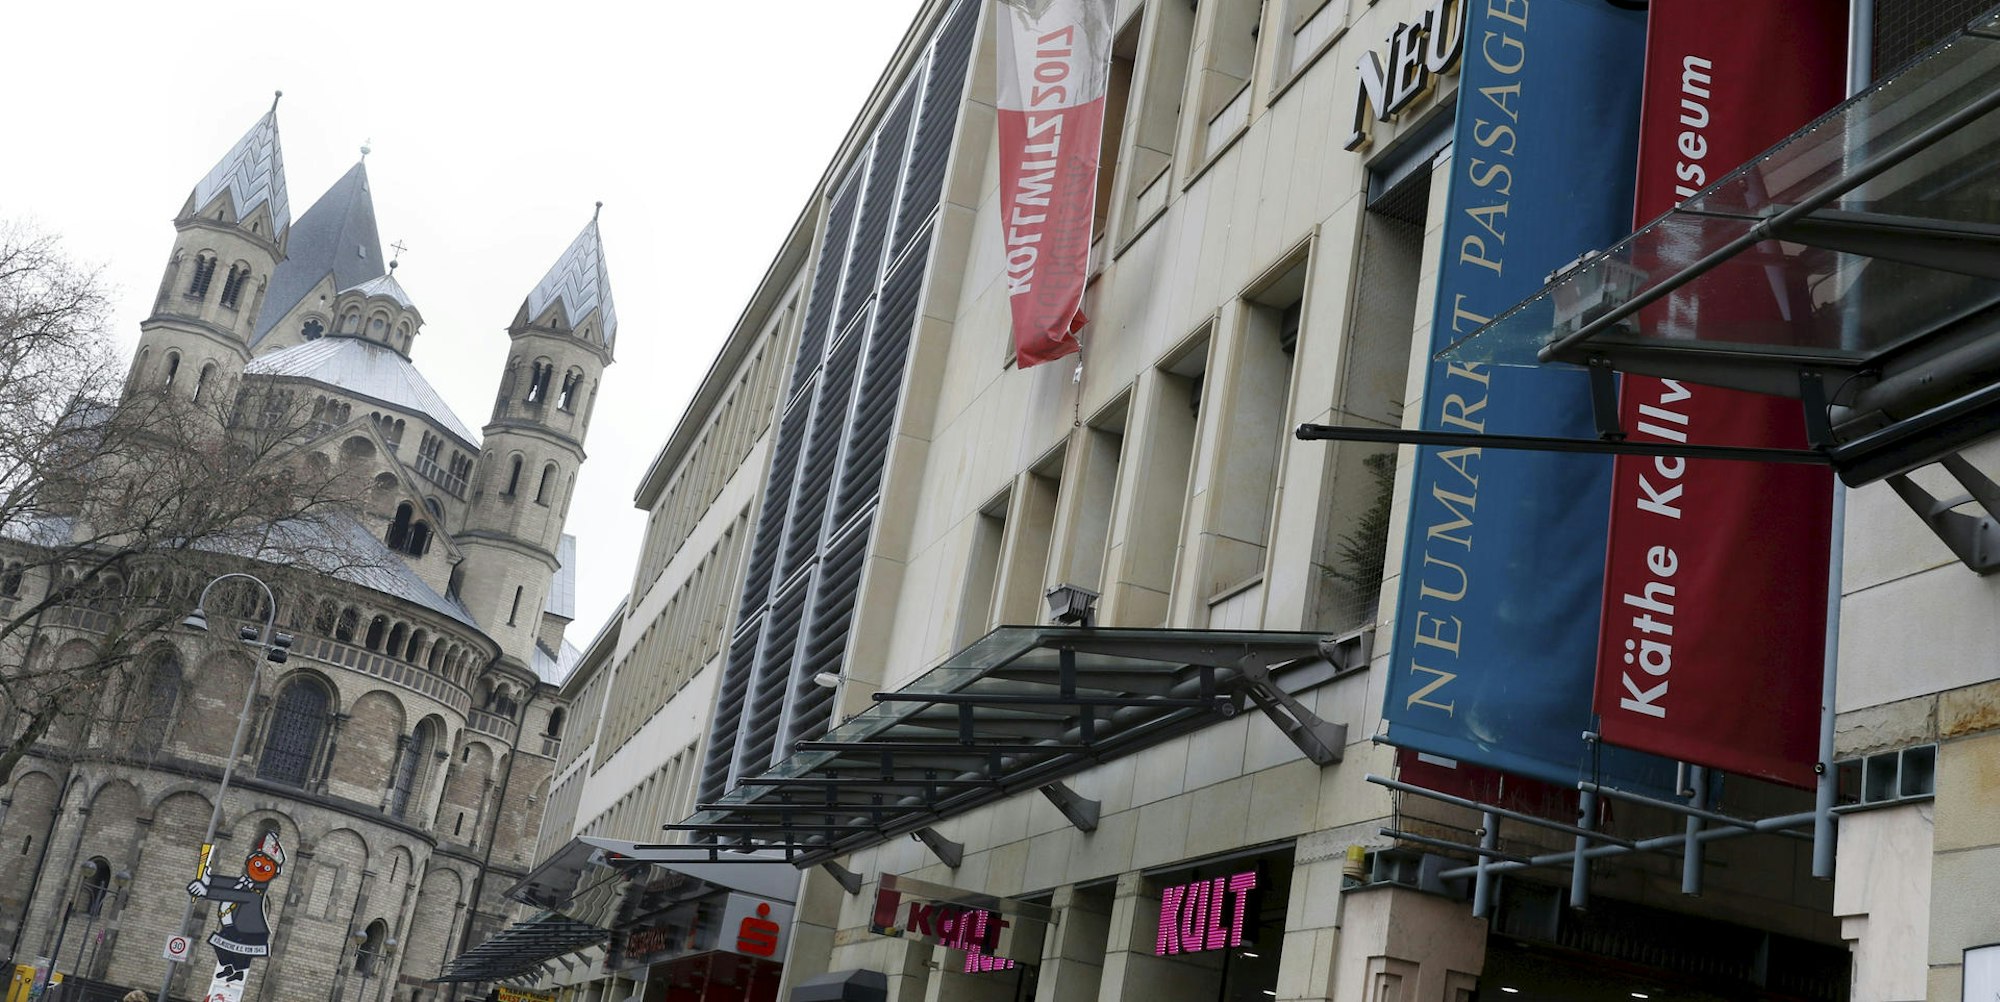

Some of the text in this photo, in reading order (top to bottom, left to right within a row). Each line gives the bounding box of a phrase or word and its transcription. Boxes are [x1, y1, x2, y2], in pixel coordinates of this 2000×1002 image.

[1406, 0, 1529, 718] NEUMARKT PASSAGE
[1620, 545, 1678, 718] Käthe
[172, 941, 183, 950] 30
[1156, 872, 1256, 956] KULT
